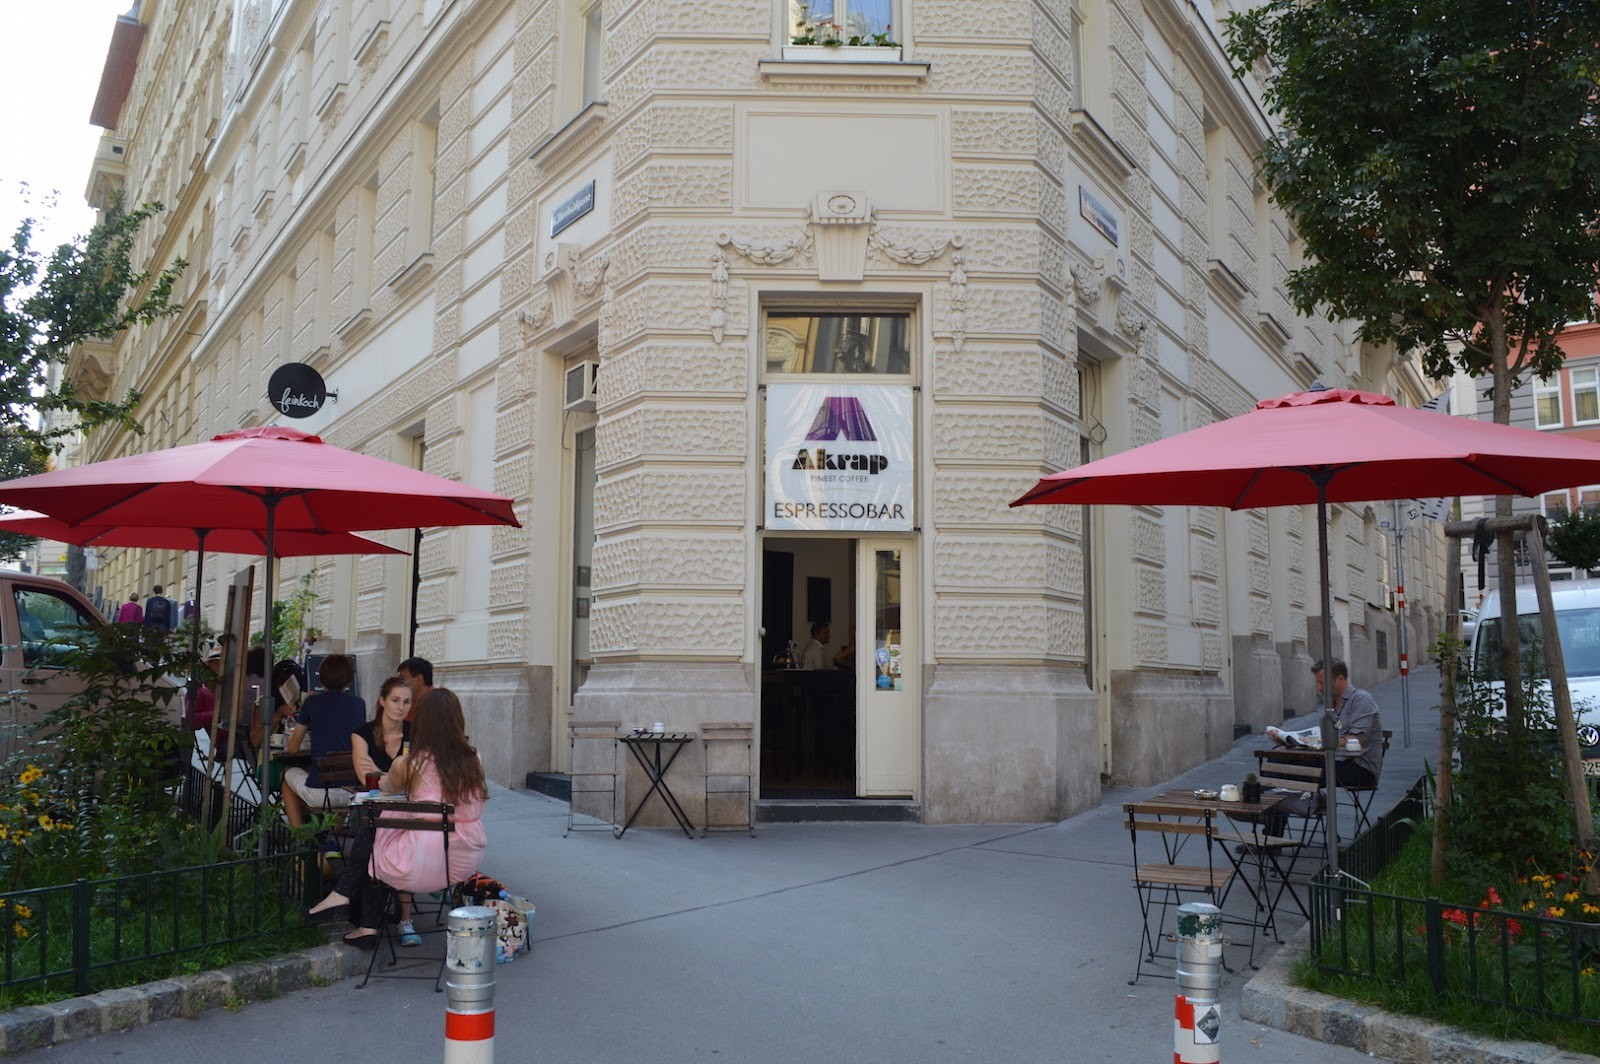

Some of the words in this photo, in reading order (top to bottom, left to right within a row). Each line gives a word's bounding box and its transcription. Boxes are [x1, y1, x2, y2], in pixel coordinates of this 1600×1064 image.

[276, 387, 320, 413] feinkoch
[791, 448, 889, 475] Akrap
[810, 475, 837, 483] FINEST
[839, 475, 869, 483] COFFEE
[774, 502, 905, 520] ESPRESSOBAR
